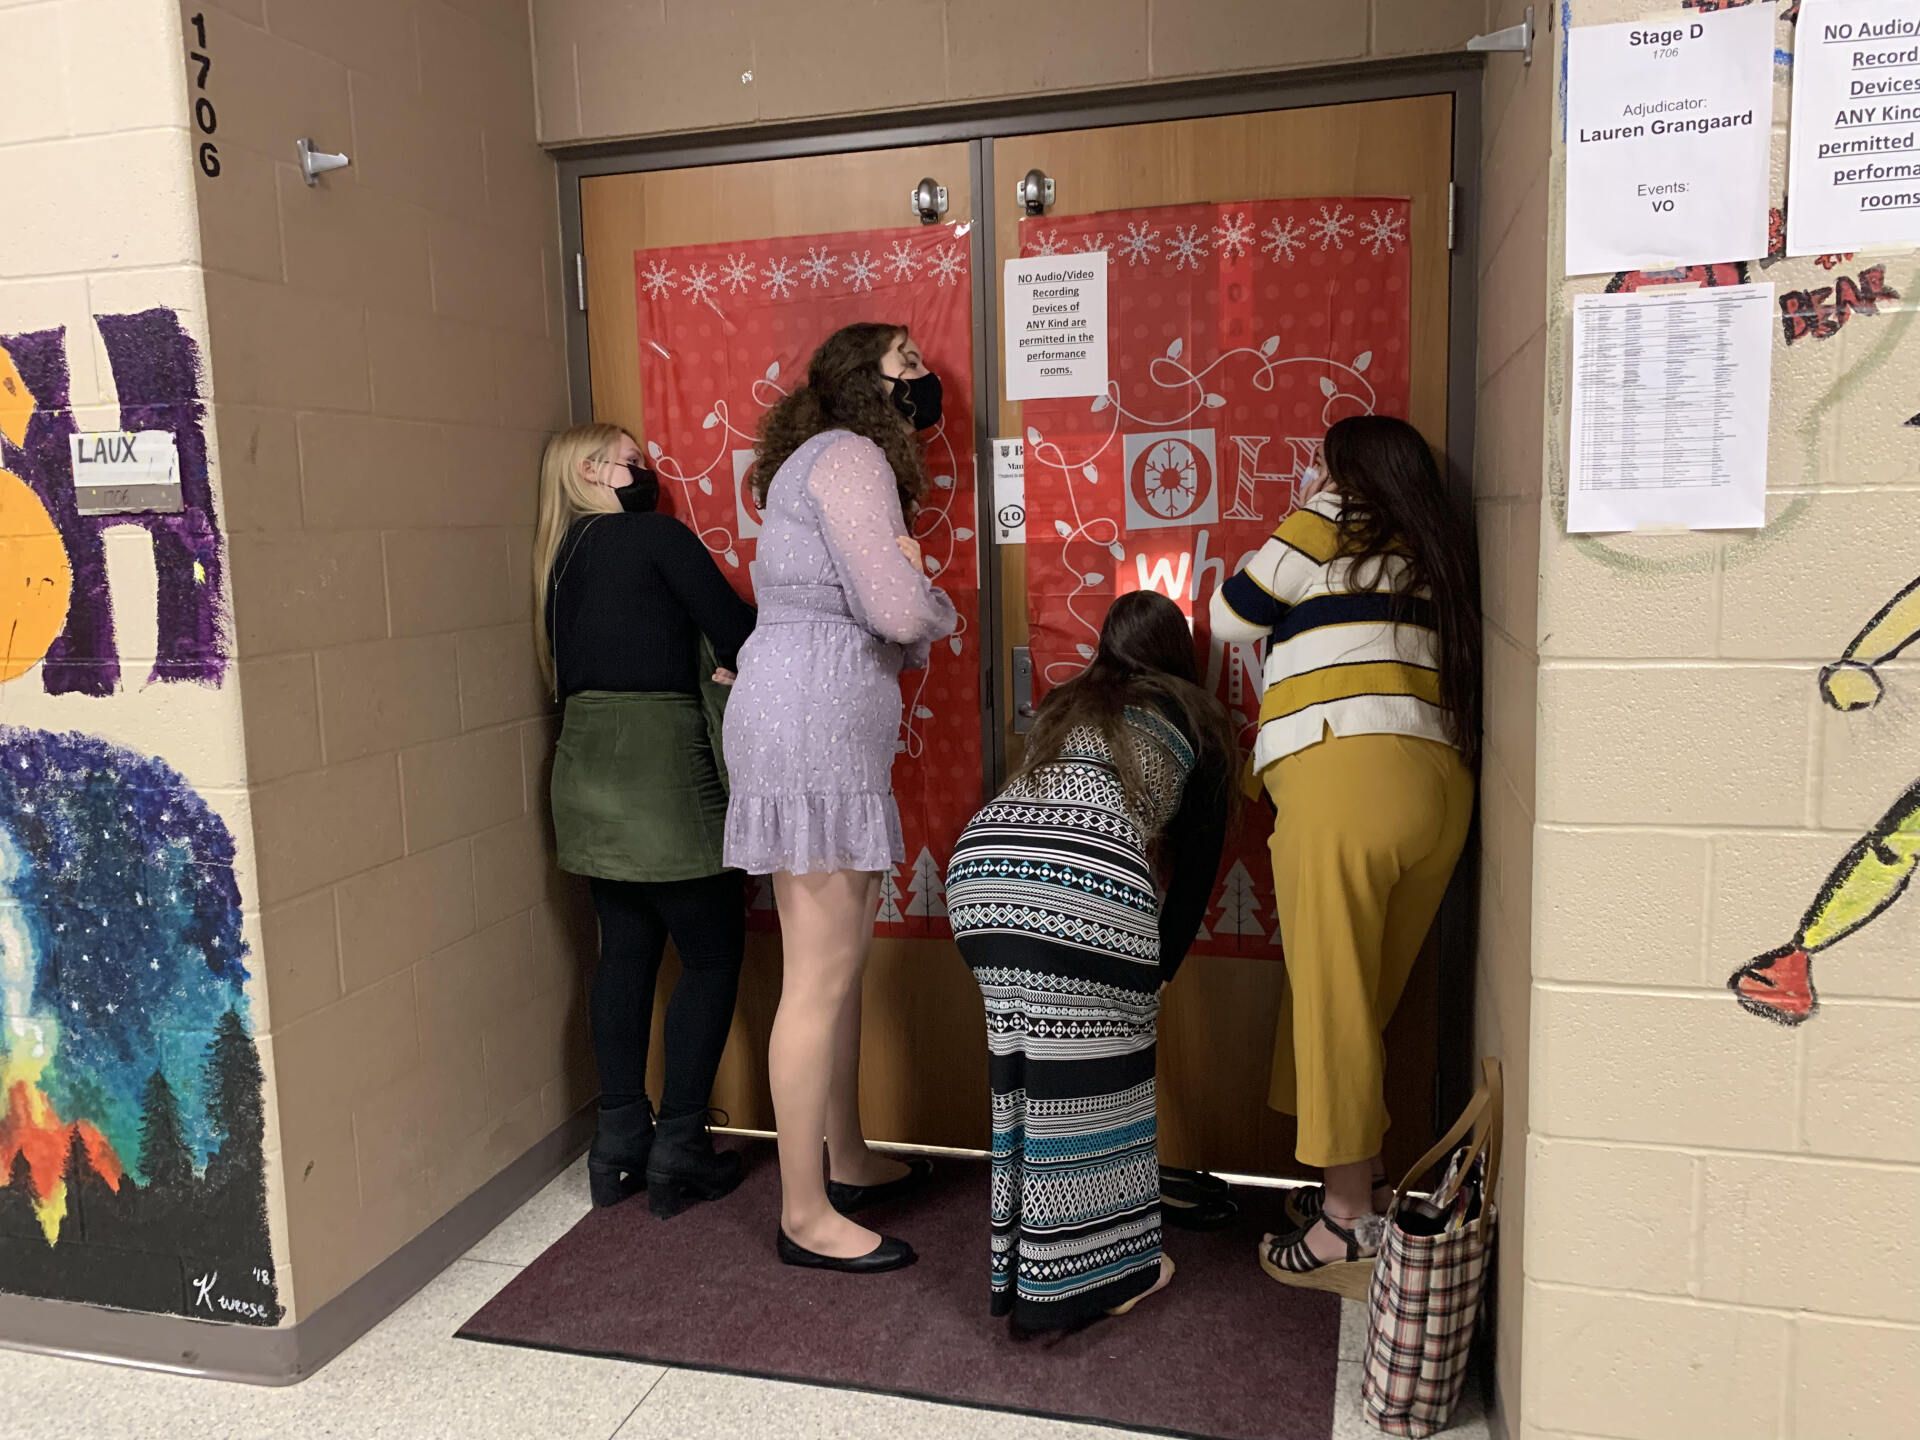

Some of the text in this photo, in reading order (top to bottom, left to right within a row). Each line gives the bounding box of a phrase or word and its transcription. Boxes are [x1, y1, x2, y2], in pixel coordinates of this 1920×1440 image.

[1629, 23, 1704, 46] Stage D
[1823, 18, 1920, 41] NO Audio/
[1652, 48, 1679, 60] 1706
[1852, 46, 1919, 67] Record
[1850, 77, 1920, 96] Devices
[191, 13, 221, 178] 1706
[1622, 98, 1708, 118] Adjudicator:
[1834, 107, 1877, 126] ANY
[1579, 110, 1753, 143] Lauren Grangaard
[1818, 132, 1914, 159] permitted
[1833, 163, 1920, 186] performa
[1637, 181, 1691, 197] Events:
[1651, 200, 1675, 213] VO
[1860, 192, 1920, 208] rooms
[1018, 270, 1094, 284] NO Audio/Video
[1032, 287, 1080, 298] Recording
[1032, 302, 1080, 314] Devices of
[1026, 318, 1087, 330] ANY Kind are
[1019, 333, 1095, 348] permitted in the
[1026, 350, 1087, 363] performance
[1040, 367, 1073, 375] rooms.
[77, 436, 138, 464] LAUX
[1003, 511, 1021, 522] 10
